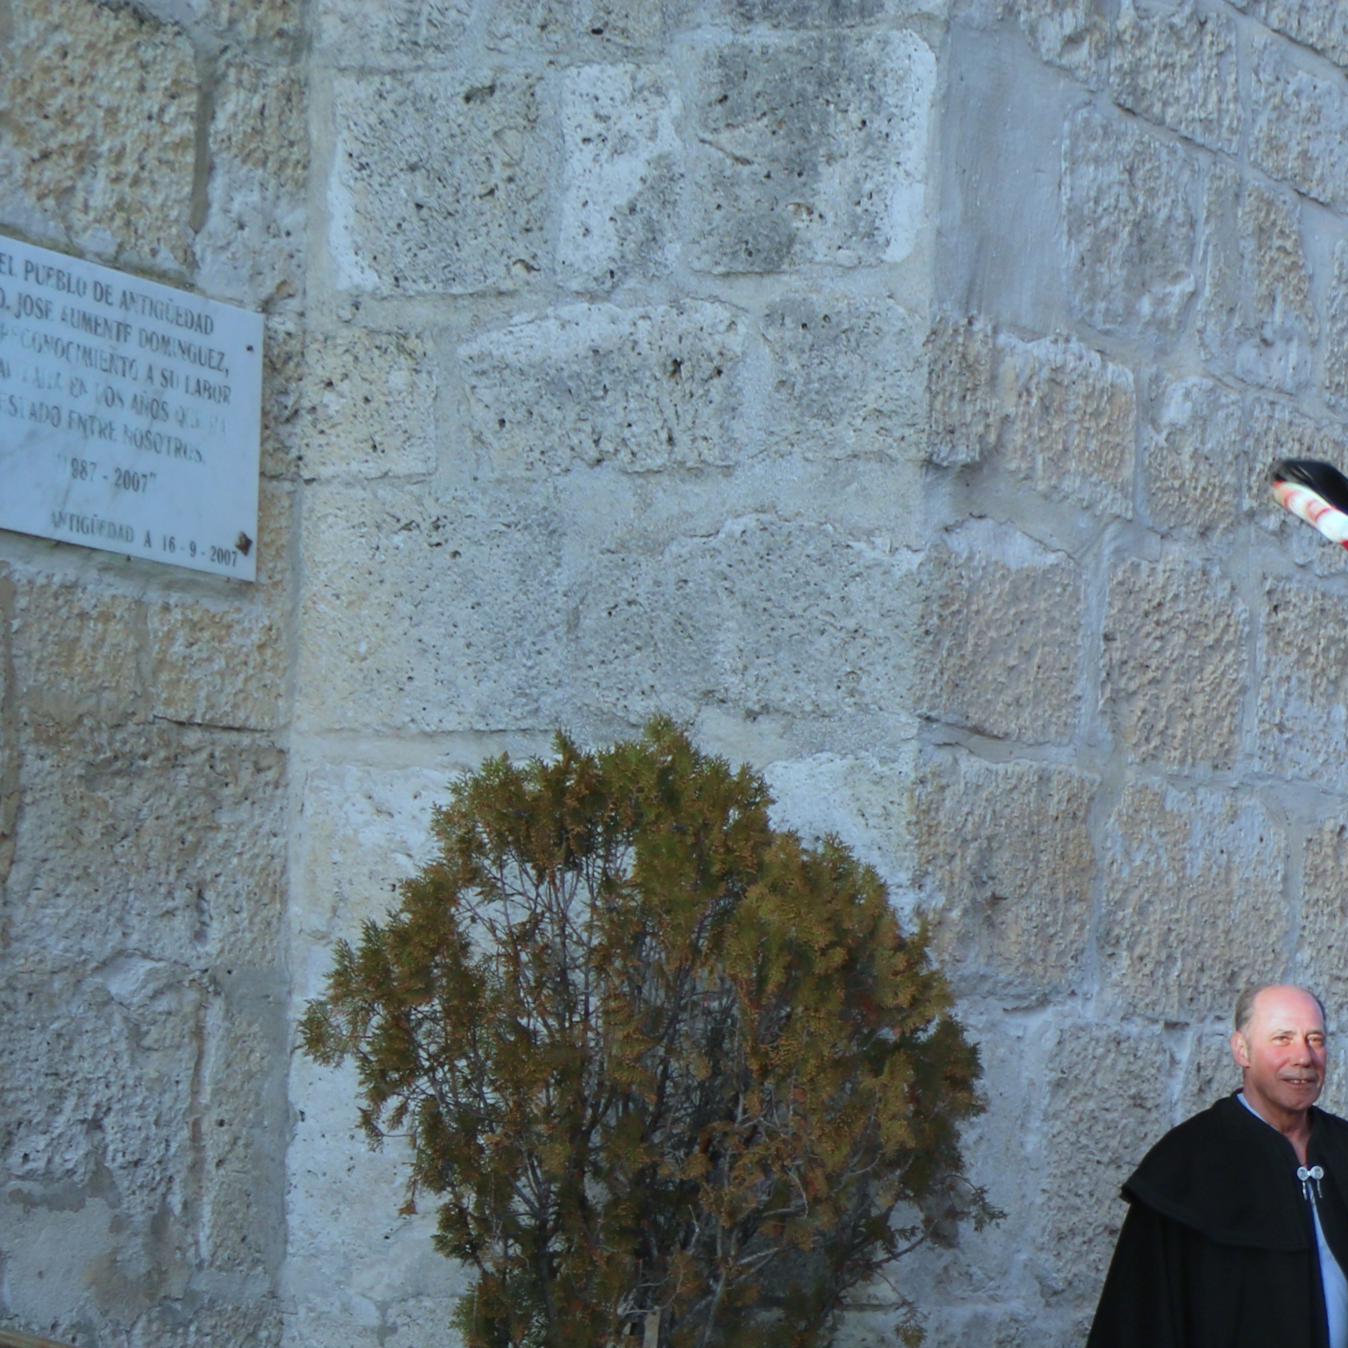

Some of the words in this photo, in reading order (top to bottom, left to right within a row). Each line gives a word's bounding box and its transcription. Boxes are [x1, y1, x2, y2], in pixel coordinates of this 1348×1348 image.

[24, 260, 87, 297] PUEBLO
[93, 281, 113, 306] DE
[119, 289, 214, 335] ANTIGÜEDAD
[146, 364, 154, 385] A
[185, 376, 231, 406] LABOR
[68, 409, 116, 442] ENTRE
[144, 530, 152, 549] A
[162, 536, 176, 553] 16
[189, 540, 197, 558] 9
[210, 545, 239, 569] 2007
